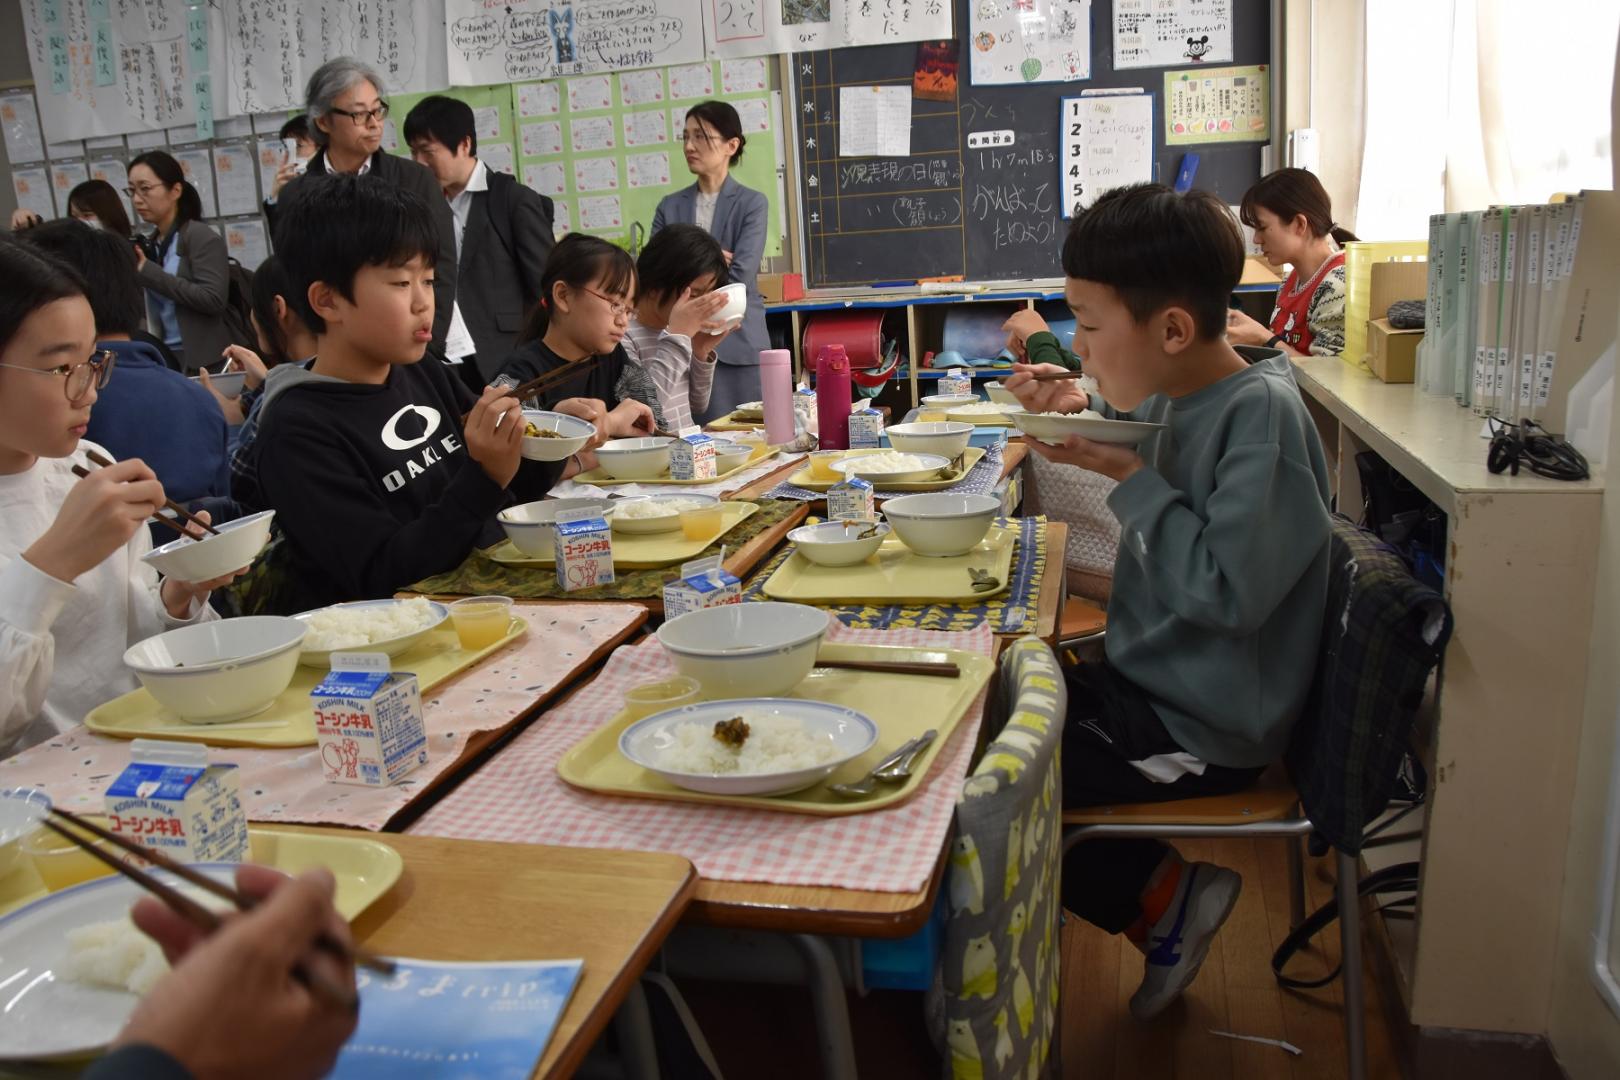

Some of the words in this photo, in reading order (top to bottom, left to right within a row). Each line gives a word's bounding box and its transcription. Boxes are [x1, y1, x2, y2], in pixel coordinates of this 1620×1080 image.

[802, 64, 812, 76] 火
[803, 101, 815, 113] 水
[1073, 103, 1079, 116] 1
[1070, 123, 1082, 136] 2
[806, 137, 816, 149] 木
[1071, 144, 1081, 157] 3
[1069, 164, 1080, 177] 4
[808, 175, 818, 187] 金
[1073, 183, 1084, 196] 5
[973, 183, 1053, 222] がんばって
[810, 211, 820, 223] 土
[563, 539, 611, 555] コーシン牛乳
[314, 711, 373, 729] コーシン牛乳
[113, 800, 148, 813] KOSHIN
[150, 801, 174, 816] MILK
[109, 815, 186, 837] コーシン牛乳
